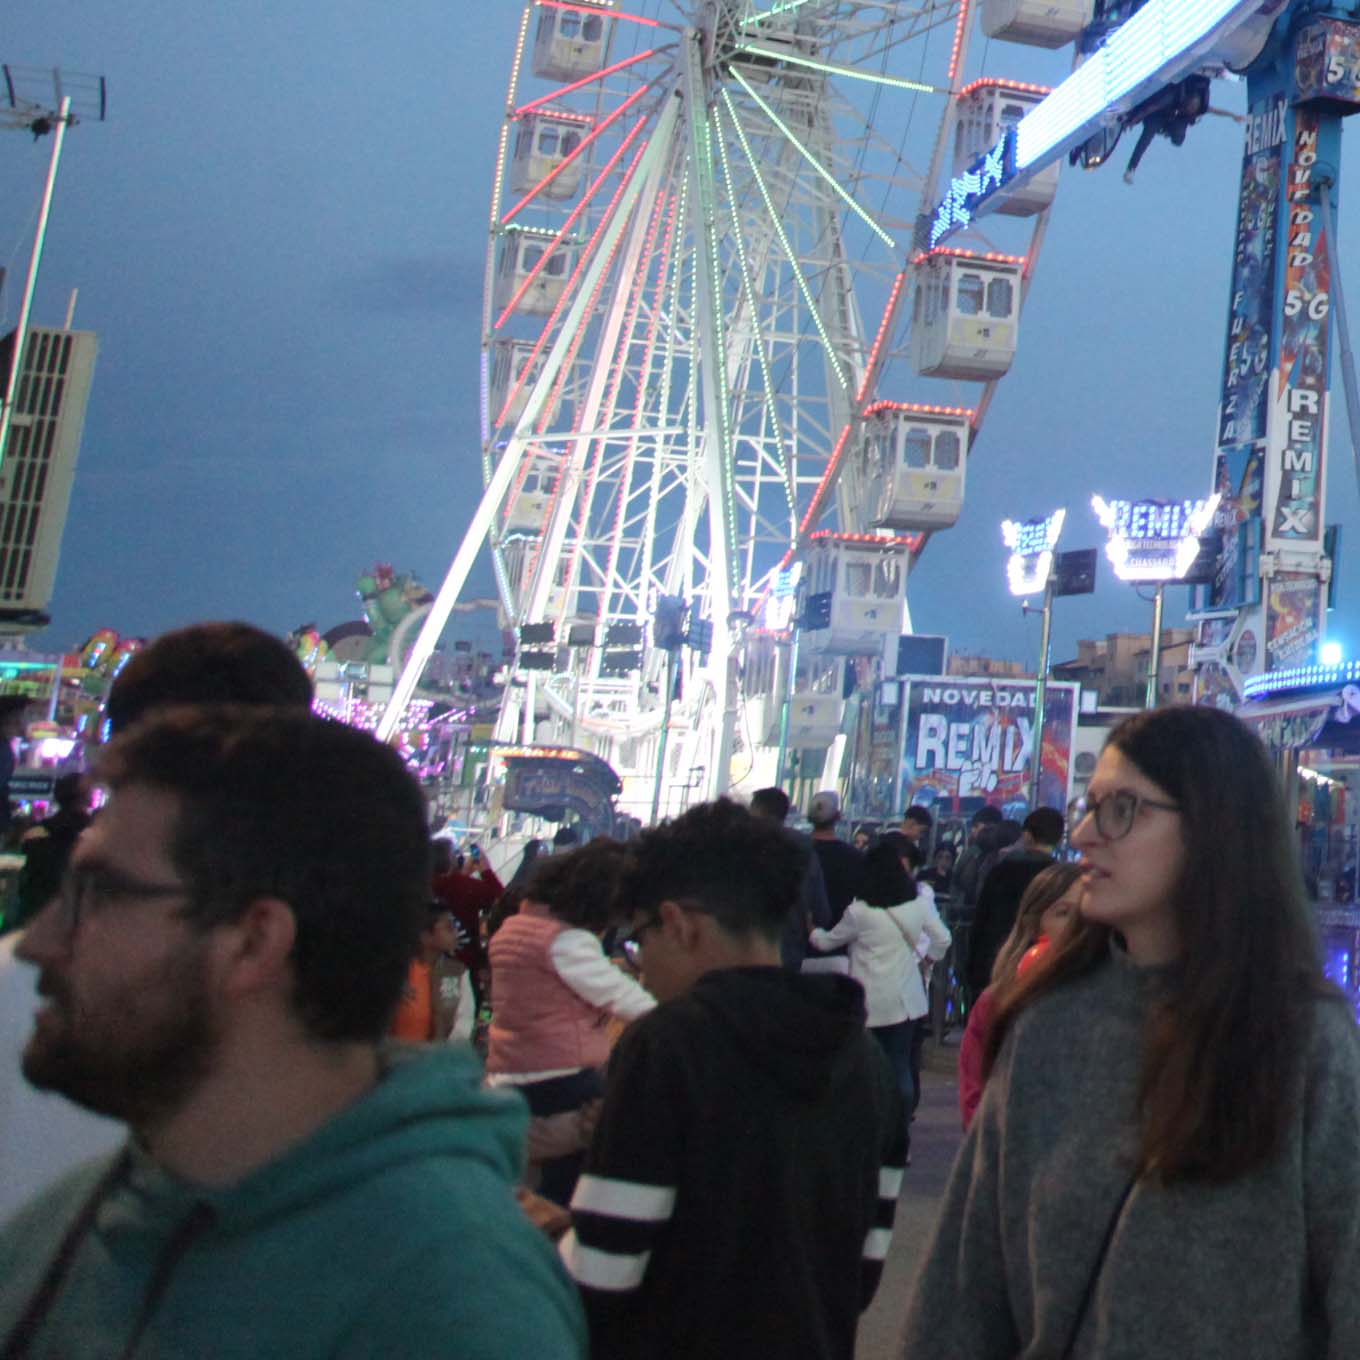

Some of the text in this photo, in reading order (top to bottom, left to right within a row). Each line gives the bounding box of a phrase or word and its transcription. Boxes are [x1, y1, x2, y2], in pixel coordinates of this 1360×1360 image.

[1246, 99, 1288, 155] REMIX
[1284, 290, 1330, 321] 5G
[1278, 388, 1319, 535] REMIX
[1108, 499, 1206, 539] REMIX
[916, 713, 1038, 772] REMIX
